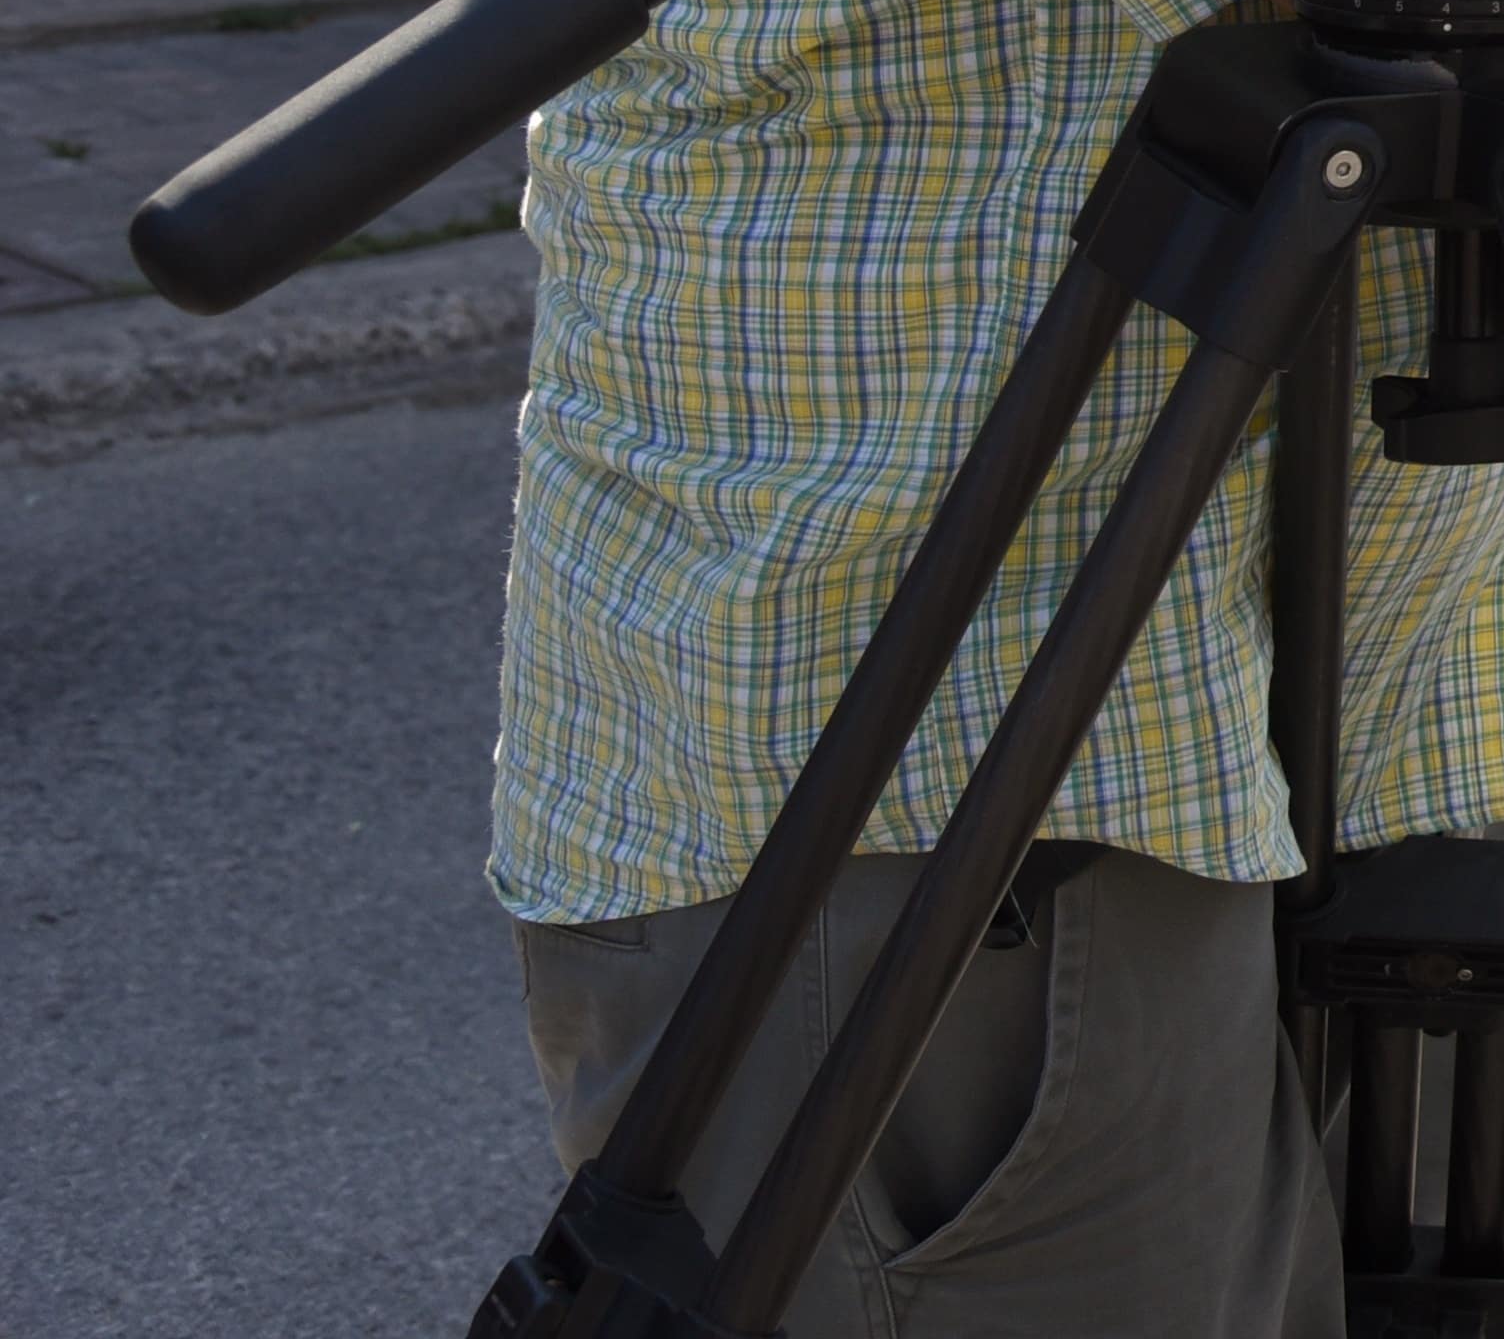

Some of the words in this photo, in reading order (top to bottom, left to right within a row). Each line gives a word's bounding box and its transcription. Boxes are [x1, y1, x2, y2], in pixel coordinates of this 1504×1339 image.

[1395, 0, 1404, 12] 5
[1442, 2, 1450, 13] 4
[1492, 1, 1501, 14] 3
